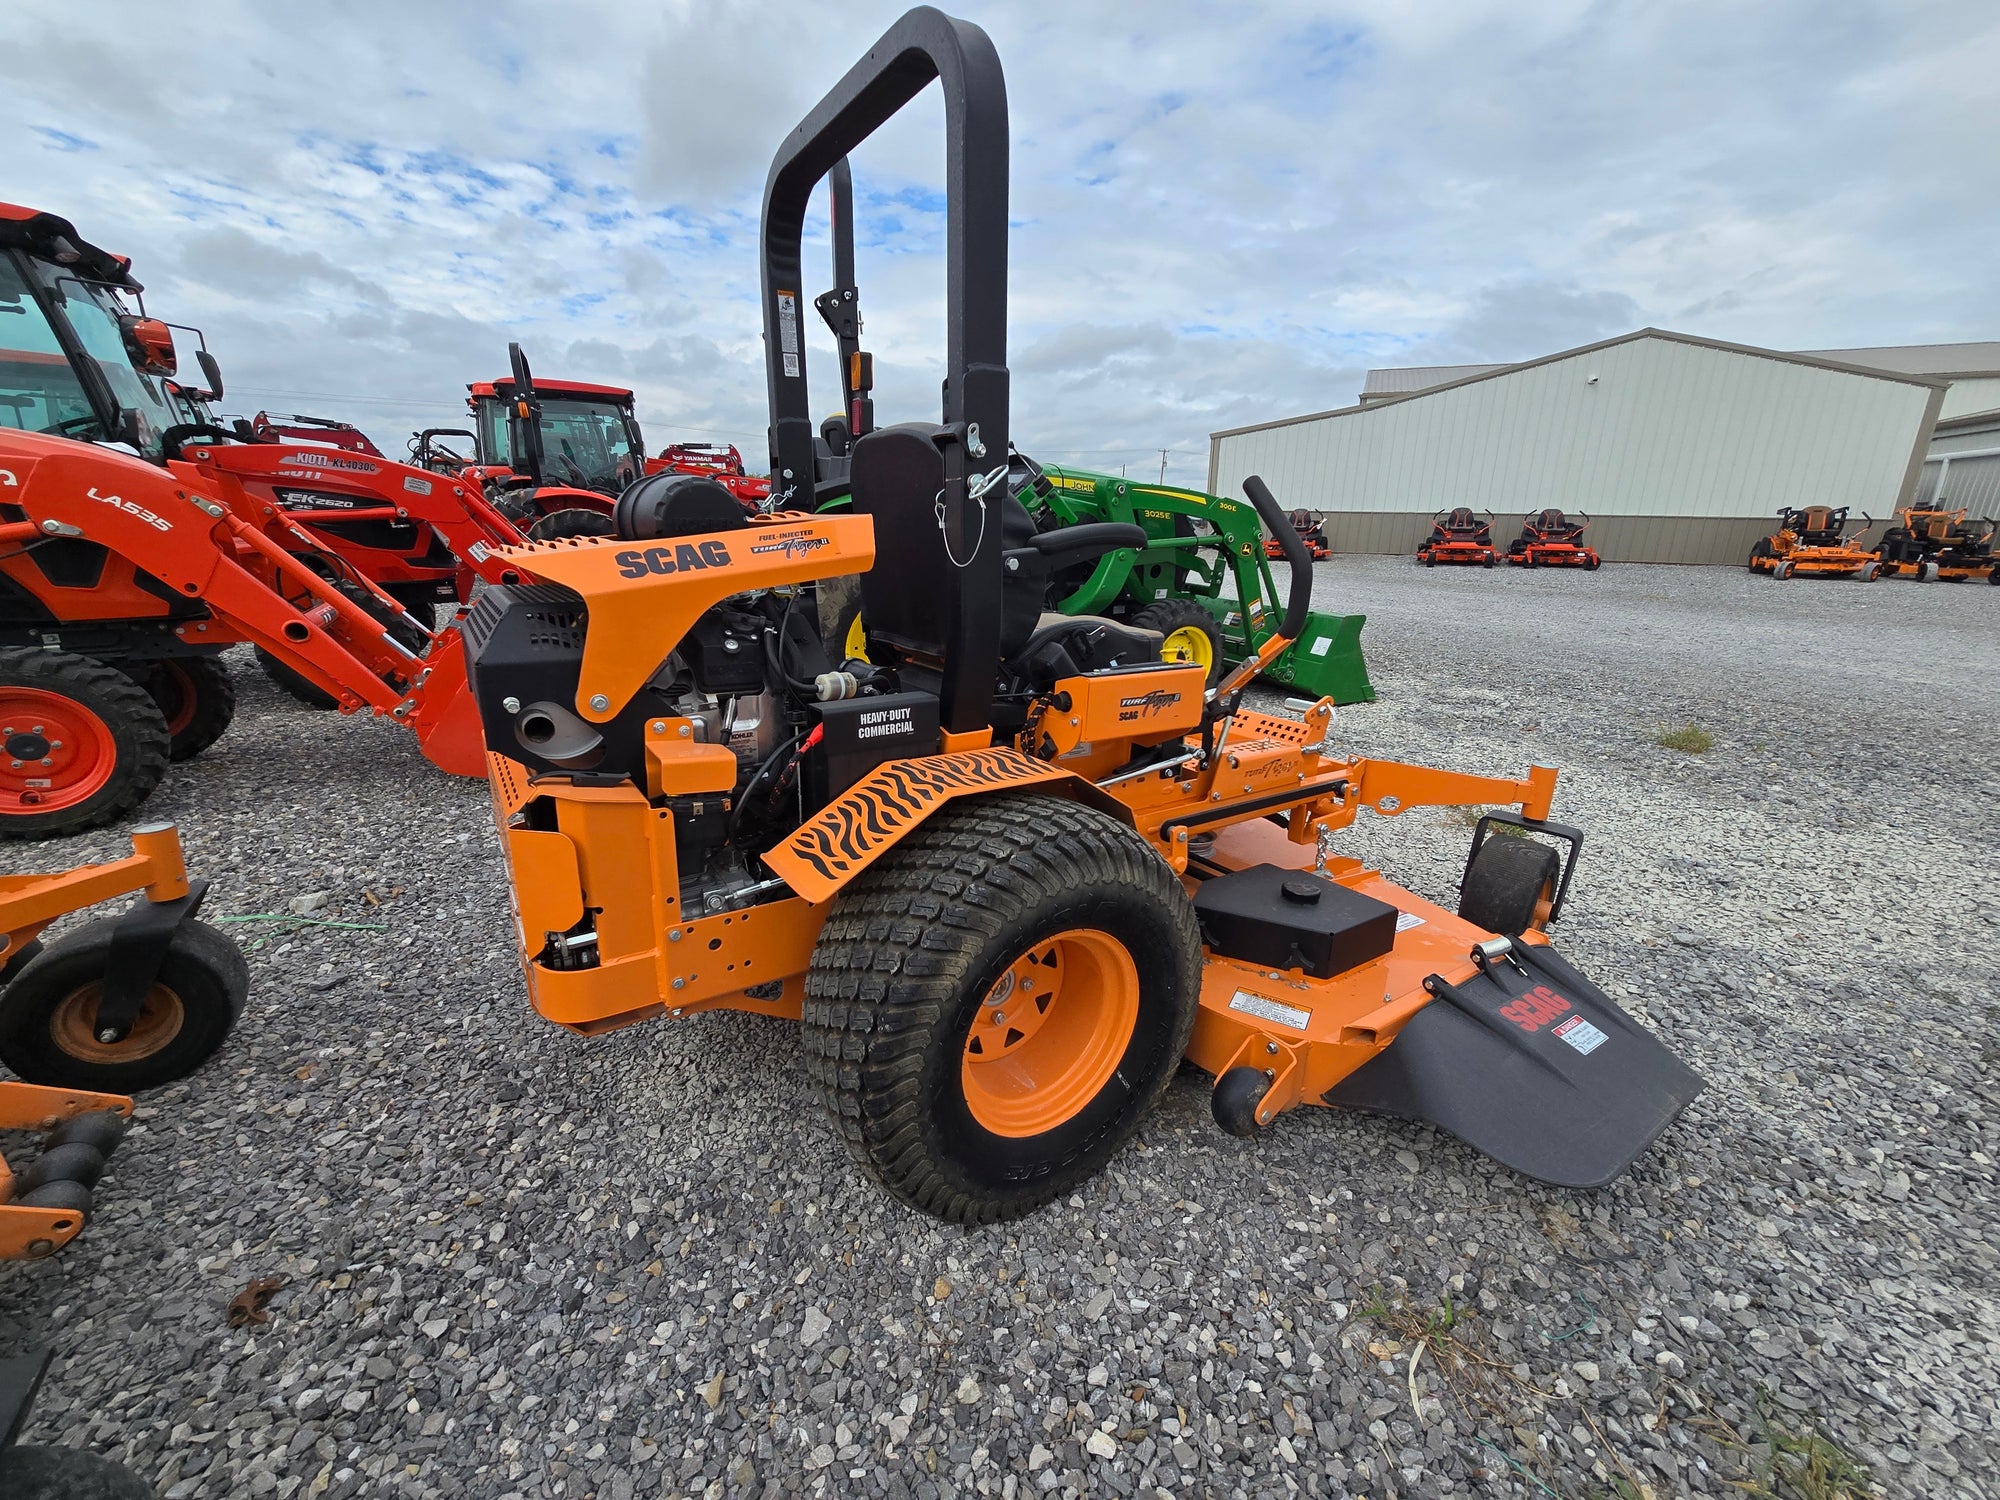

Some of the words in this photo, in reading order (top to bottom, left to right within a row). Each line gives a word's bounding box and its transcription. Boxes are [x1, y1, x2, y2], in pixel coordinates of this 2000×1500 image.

[296, 452, 328, 467] KIOTI
[1070, 481, 1096, 493] JOHN
[86, 487, 174, 532] LA535
[1144, 509, 1172, 520] 3025E
[759, 529, 814, 542] FUEL-INJECTED
[615, 540, 732, 579] SCAG
[1121, 697, 1148, 706] TURF
[860, 707, 911, 725] HEAVY-DUTY
[1119, 711, 1138, 721] SCAG
[858, 721, 914, 739] COMMERCIAL
[1499, 985, 1573, 1033] SCAG
